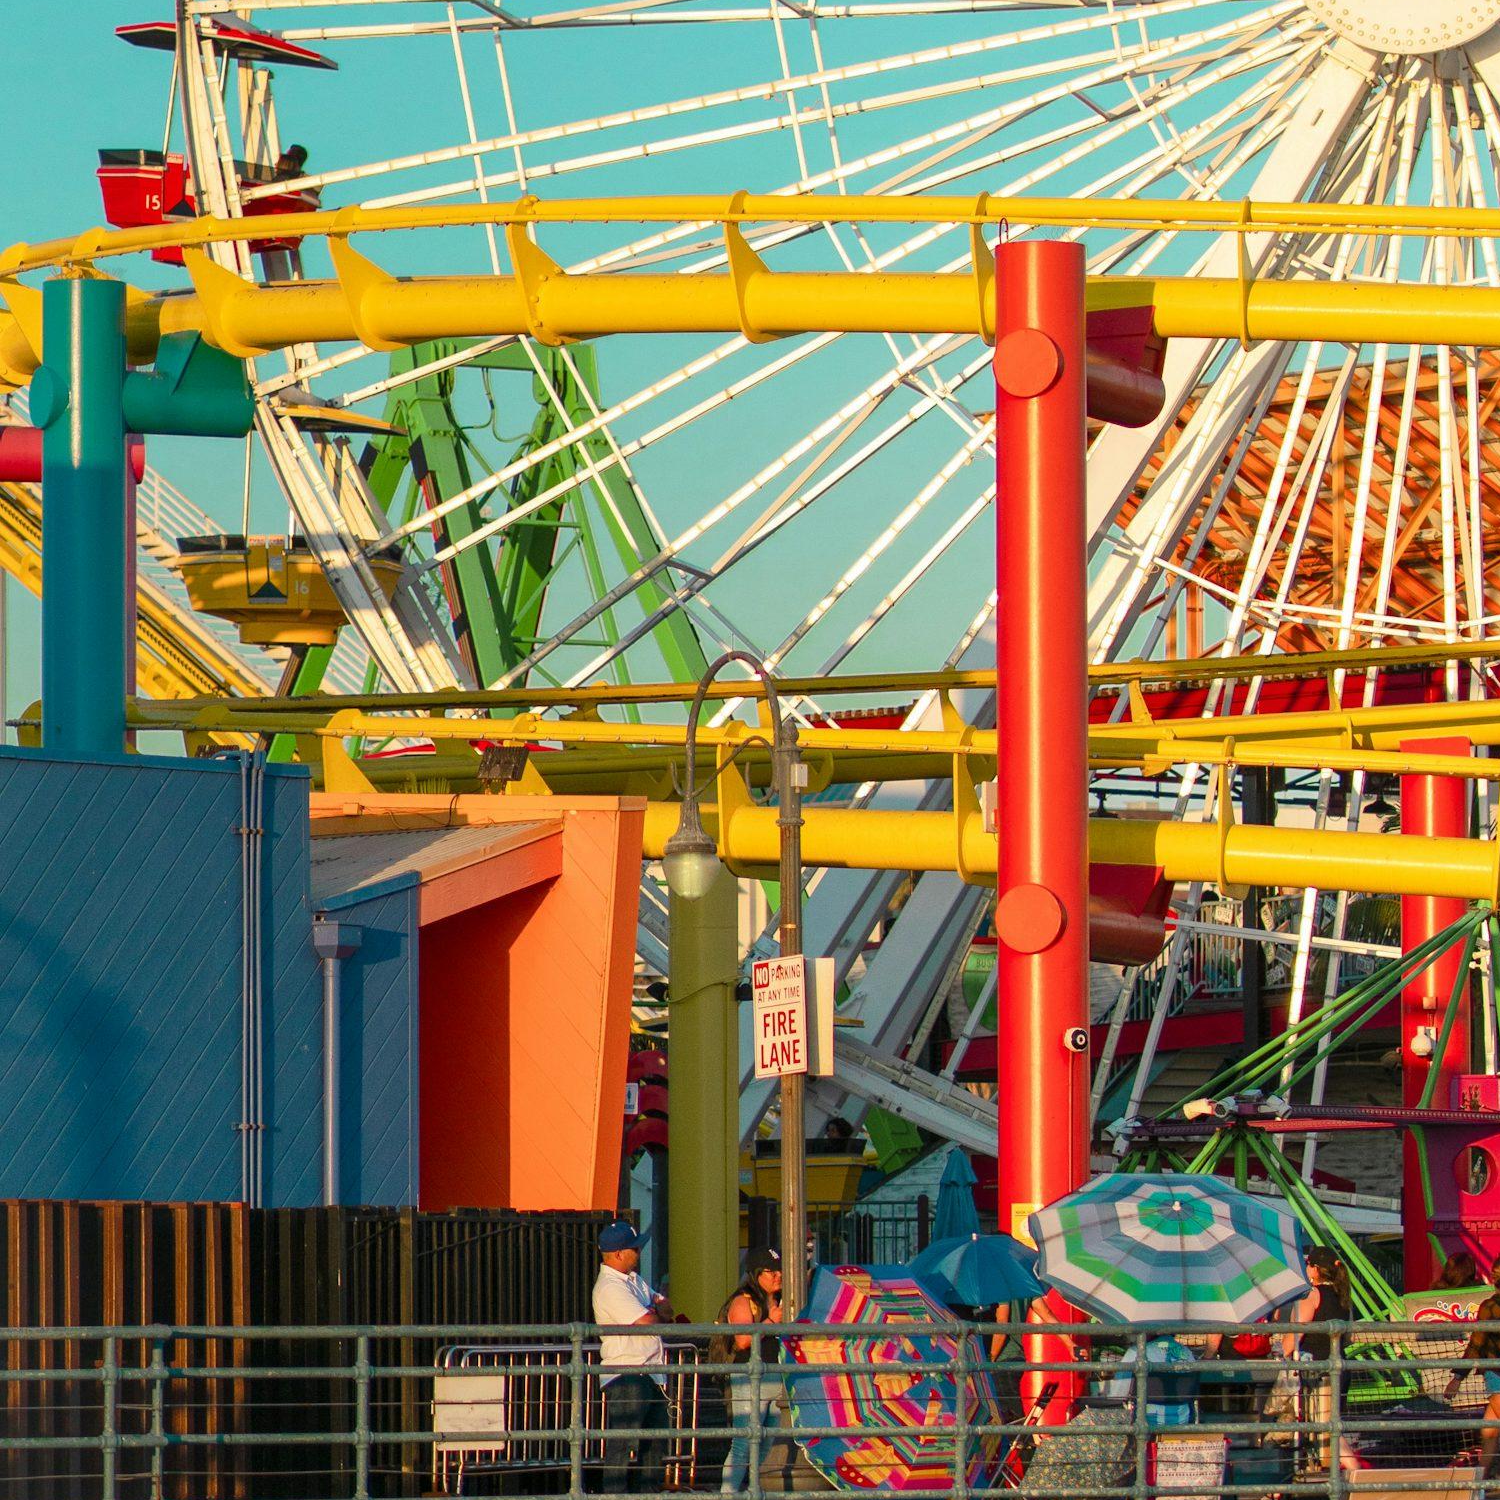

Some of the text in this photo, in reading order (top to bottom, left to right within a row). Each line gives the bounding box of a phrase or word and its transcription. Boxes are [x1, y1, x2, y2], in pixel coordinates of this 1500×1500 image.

[145, 194, 161, 210] 15
[294, 580, 310, 595] 16
[755, 964, 801, 988] NO PARKING
[757, 986, 801, 1003] AT ANY TIME
[763, 1009, 797, 1038] FIRE
[761, 1039, 801, 1069] LANE
